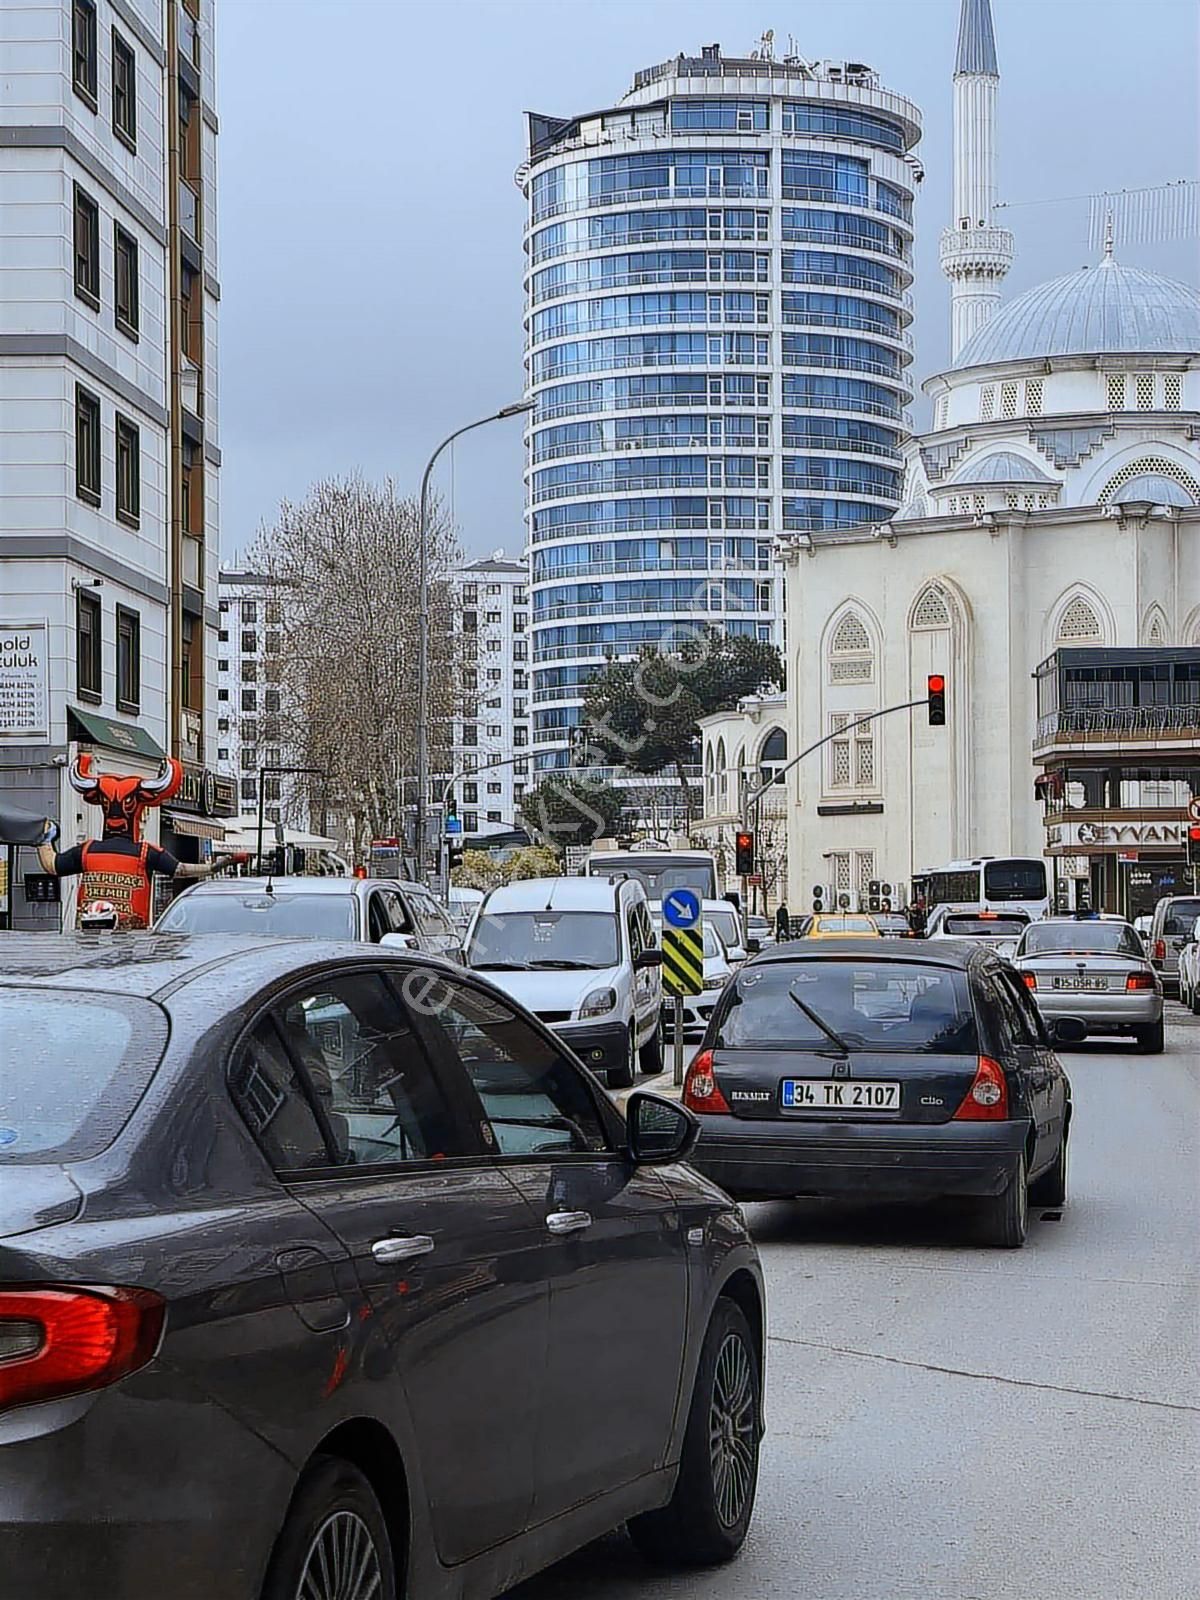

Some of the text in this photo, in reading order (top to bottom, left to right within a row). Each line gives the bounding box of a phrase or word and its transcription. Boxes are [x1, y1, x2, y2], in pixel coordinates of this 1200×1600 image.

[0, 636, 30, 653] old
[0, 653, 38, 668] uluk
[794, 1085, 814, 1104] 34
[823, 1086, 844, 1105] TK
[853, 1086, 896, 1106] 2107
